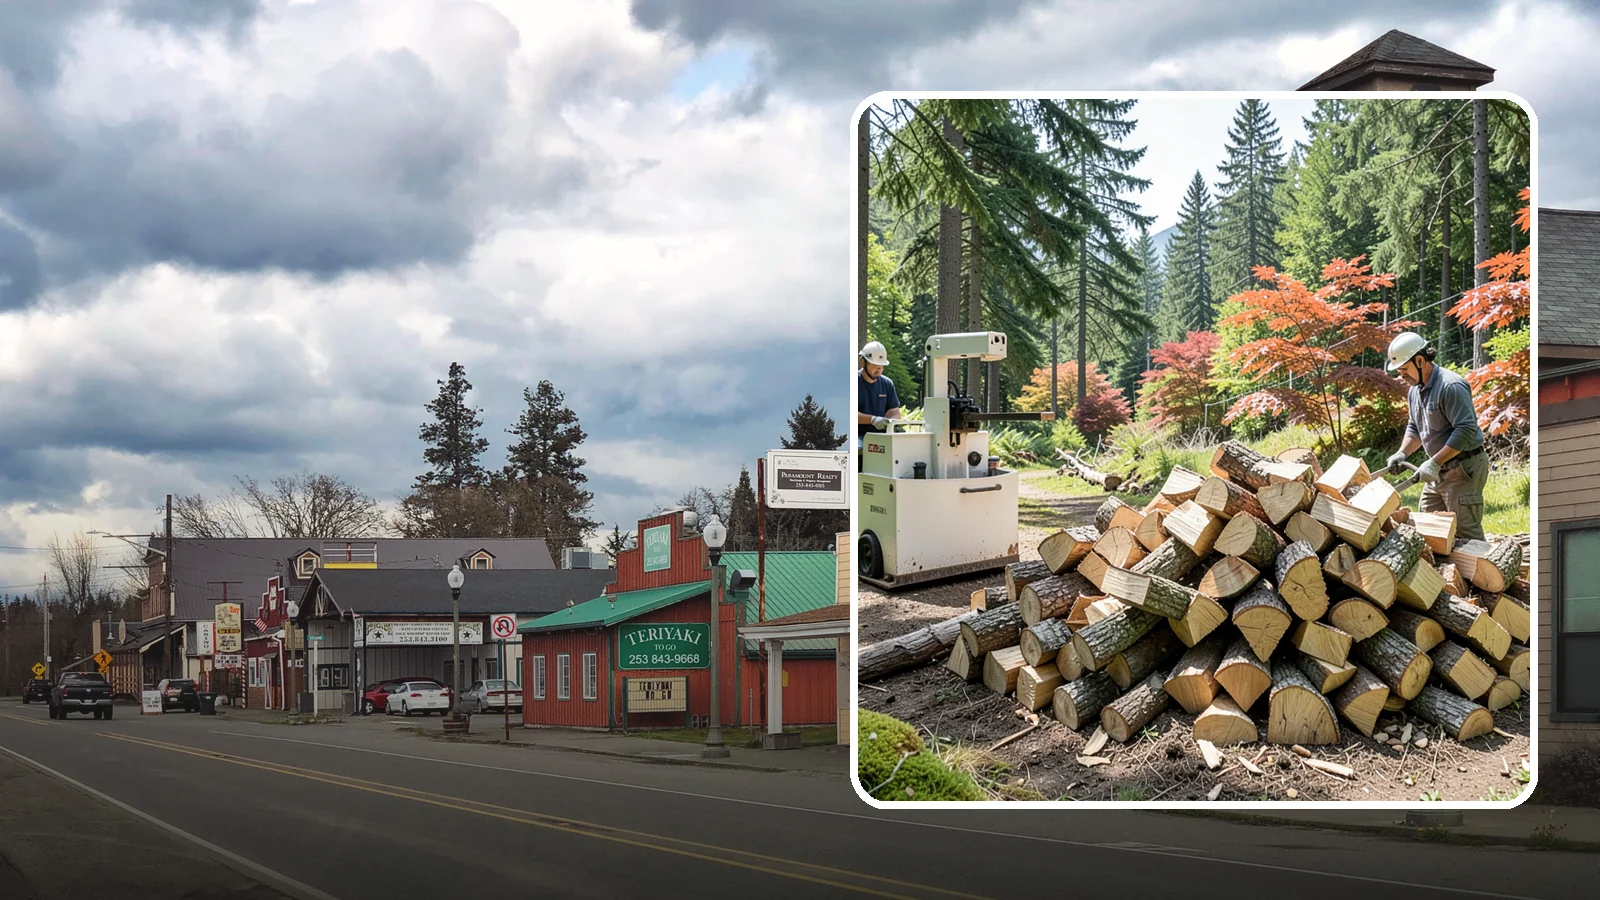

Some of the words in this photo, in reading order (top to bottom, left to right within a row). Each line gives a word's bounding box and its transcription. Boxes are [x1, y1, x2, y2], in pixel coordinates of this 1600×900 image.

[781, 471, 815, 479] PARAMOUNT
[817, 472, 839, 480] REALTY
[624, 627, 702, 646] TERIYAKI
[629, 654, 648, 665] 253
[651, 654, 700, 664] 843-9668
[639, 681, 672, 691] TERIYAKI
[661, 690, 672, 700] GO
